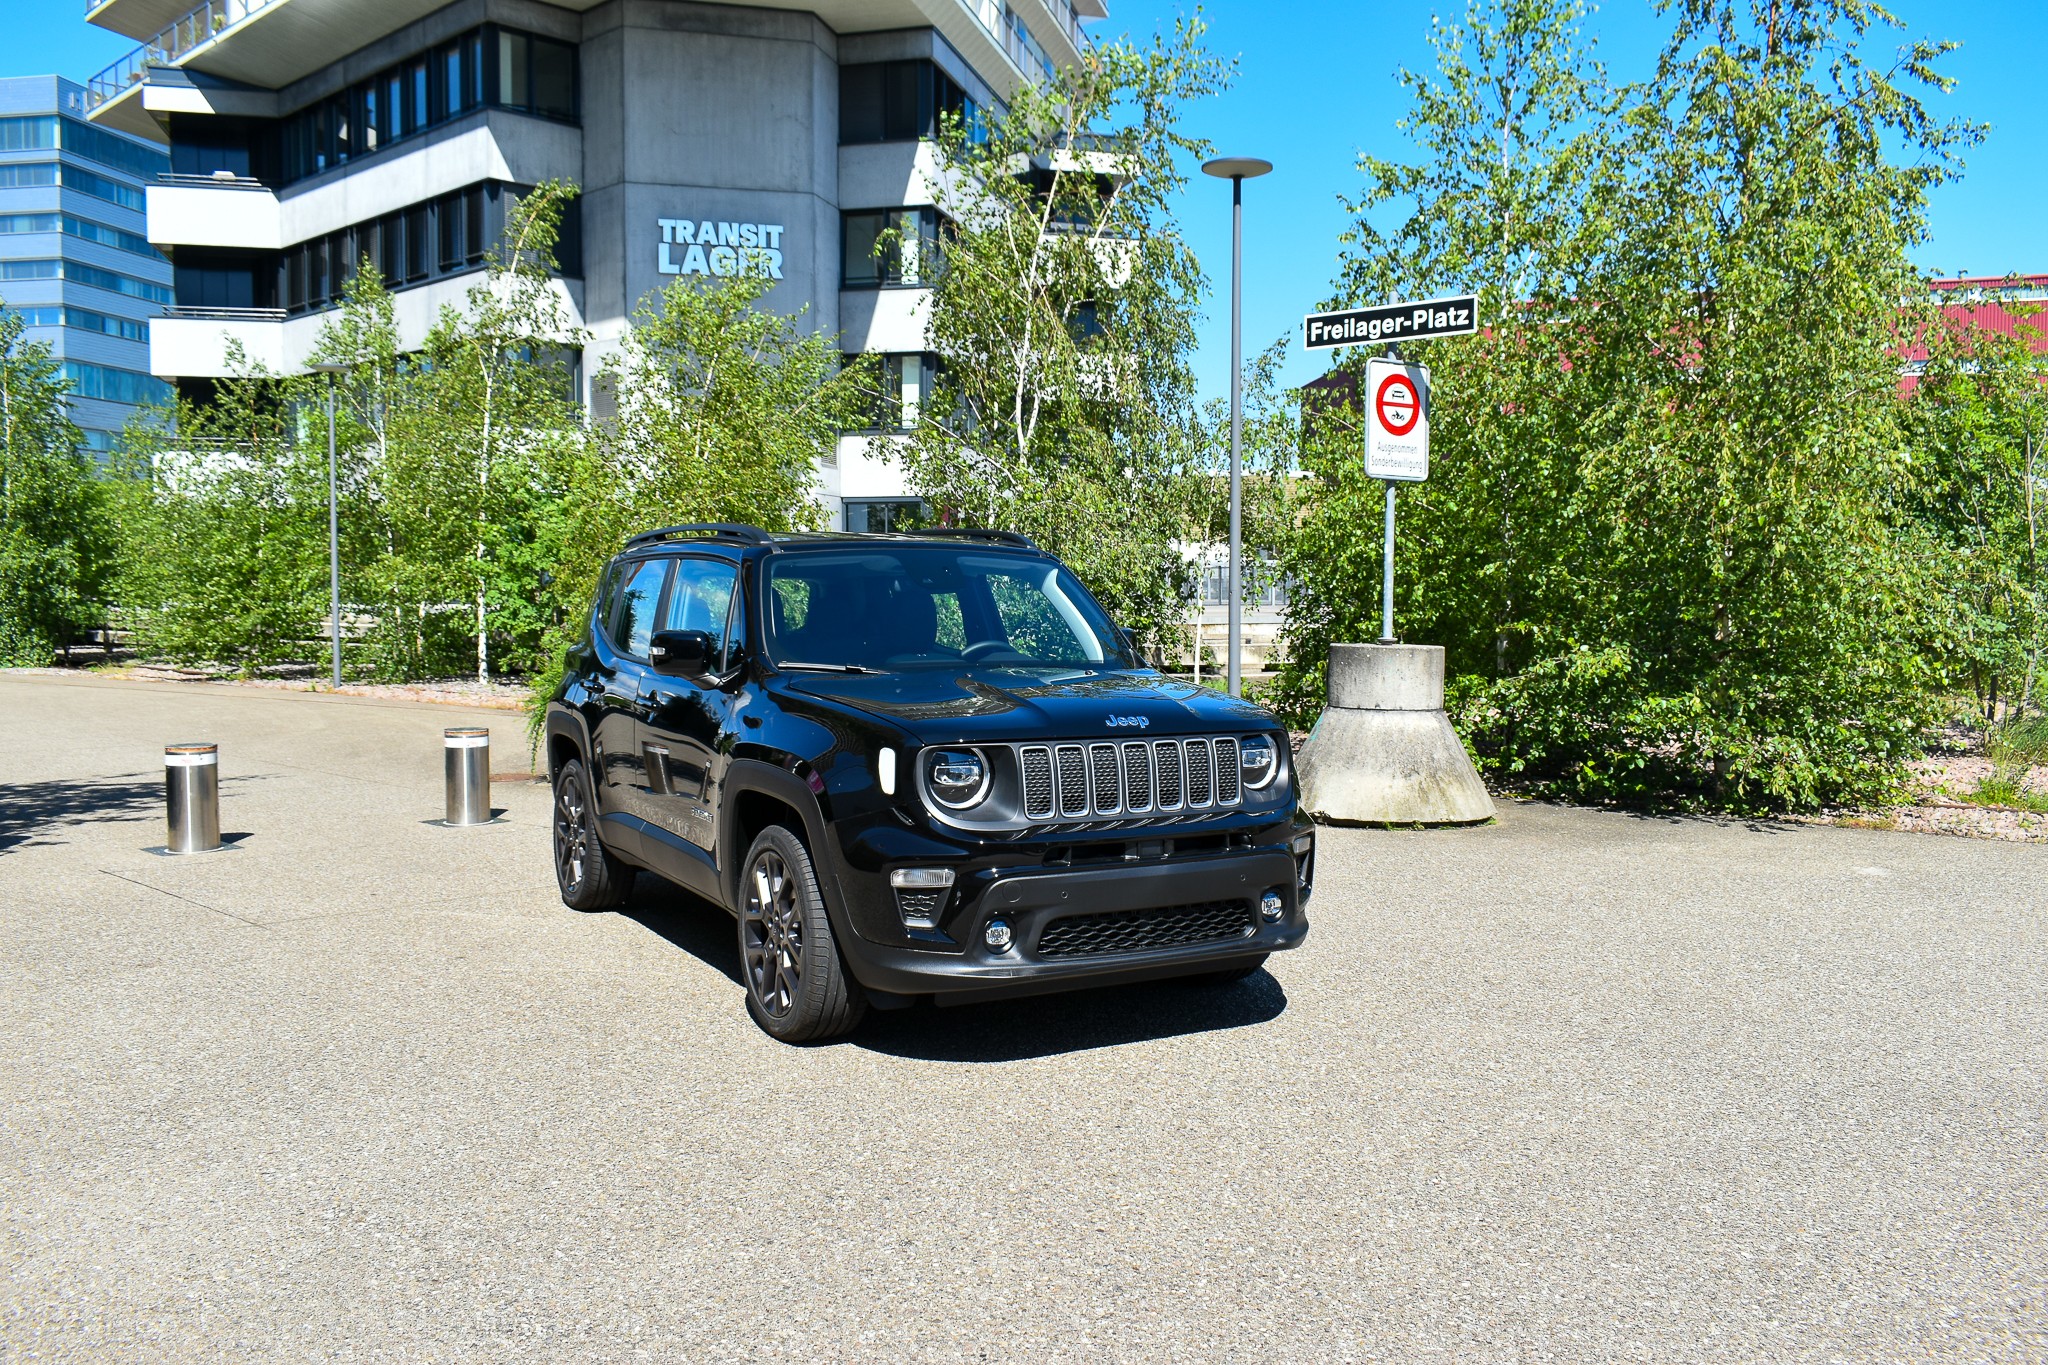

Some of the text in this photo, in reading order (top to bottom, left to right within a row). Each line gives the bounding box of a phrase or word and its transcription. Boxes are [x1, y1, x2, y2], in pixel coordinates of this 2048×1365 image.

[658, 218, 783, 249] TRANSIT
[1310, 307, 1470, 342] Freilager-Platz
[1377, 441, 1418, 455] Ausgenommen
[1371, 455, 1423, 473] Sonderbewilligung
[1105, 714, 1150, 729] Jeep
